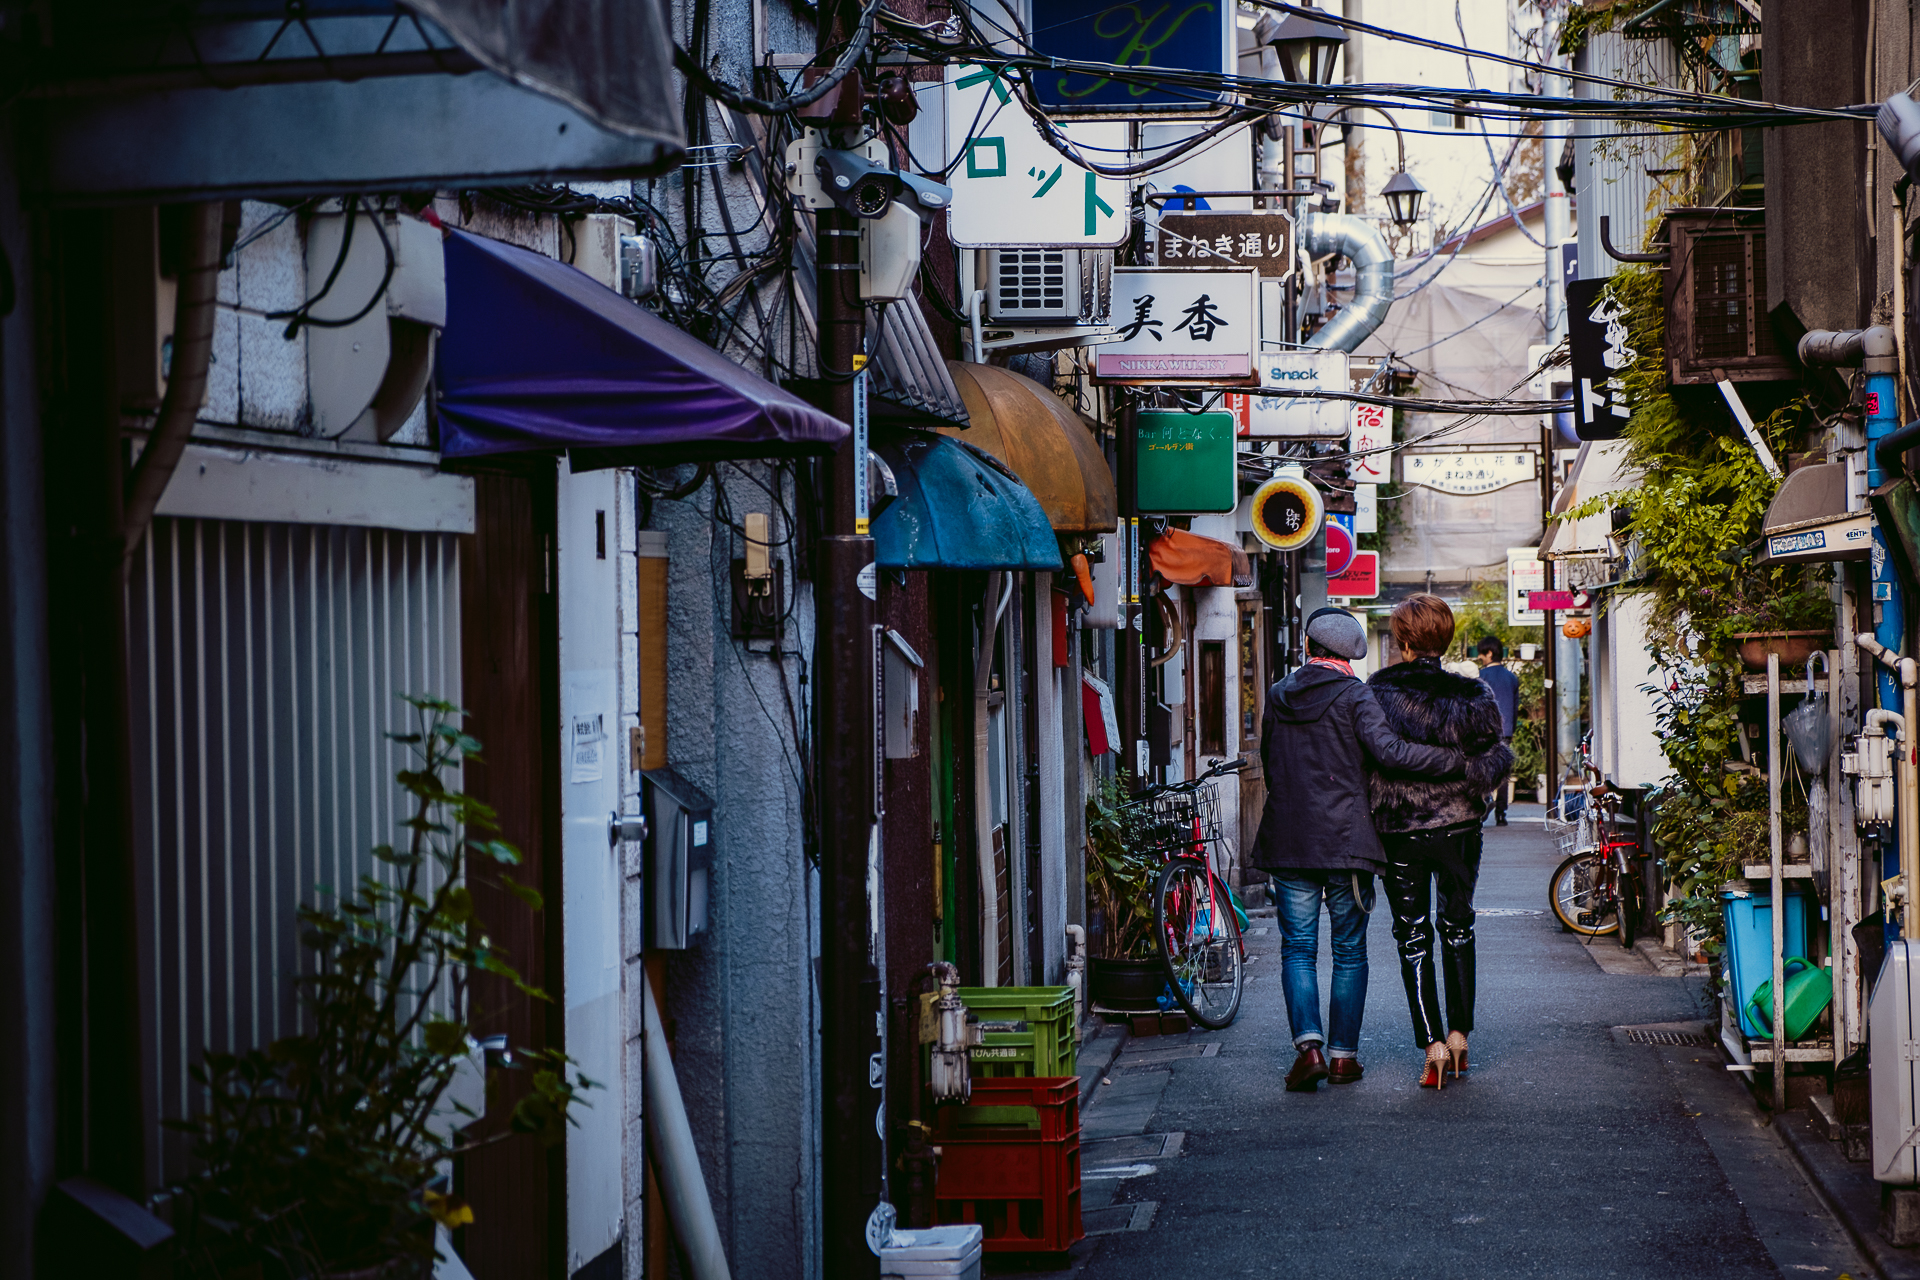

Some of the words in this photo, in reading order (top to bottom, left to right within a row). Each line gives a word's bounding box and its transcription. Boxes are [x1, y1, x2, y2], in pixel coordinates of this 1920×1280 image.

[1164, 233, 1284, 258] まねき通り
[1117, 294, 1229, 342] 美香
[1119, 360, 1168, 370] NIKKA
[1168, 360, 1228, 370] WHISKY
[1271, 368, 1319, 380] Snack
[1138, 428, 1157, 439] Bar
[1148, 442, 1195, 451] ゴールデン街
[1445, 469, 1495, 480] まねき通り
[1286, 509, 1300, 532] ひまわり
[1529, 594, 1573, 602] CREMAS
